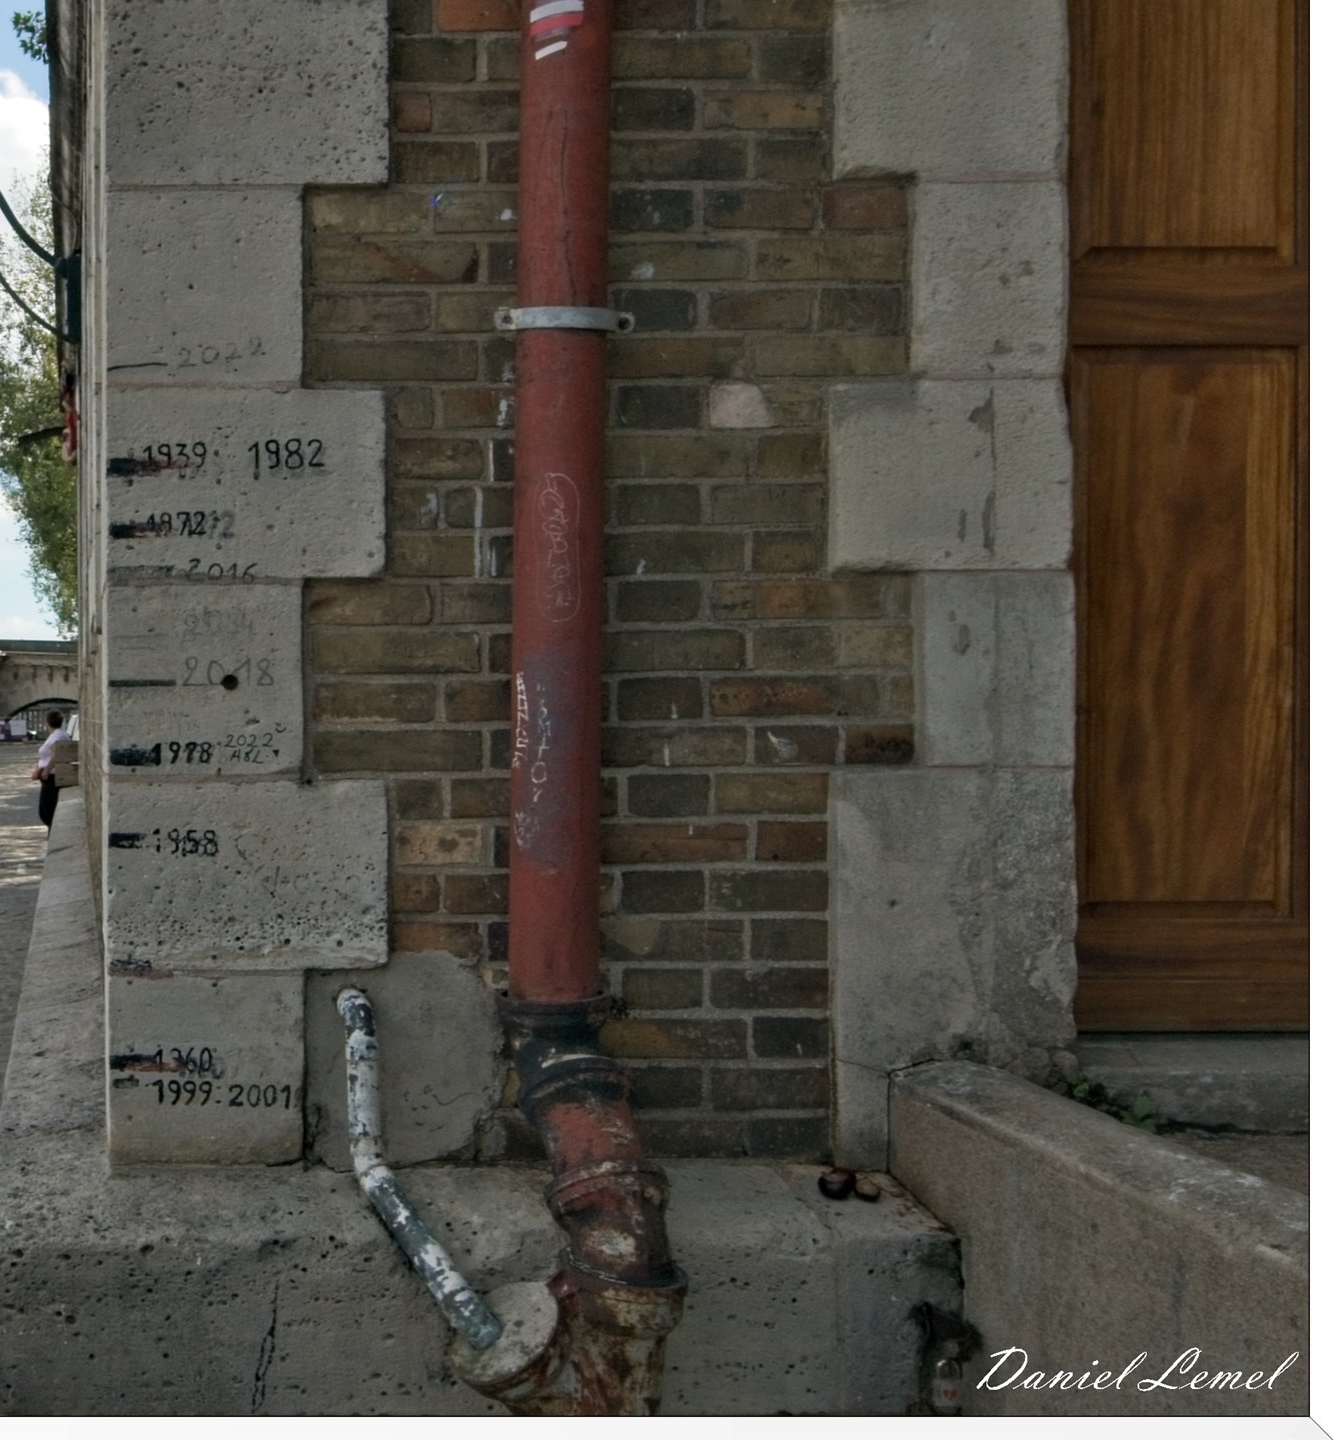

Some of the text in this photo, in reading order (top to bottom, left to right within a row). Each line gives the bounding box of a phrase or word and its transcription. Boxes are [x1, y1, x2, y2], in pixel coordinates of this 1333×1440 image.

[142, 438, 326, 471] 1939 1982
[185, 558, 258, 584] 2016
[181, 656, 274, 687] 2018
[224, 732, 274, 748] 2022
[228, 1084, 293, 1111] 2001
